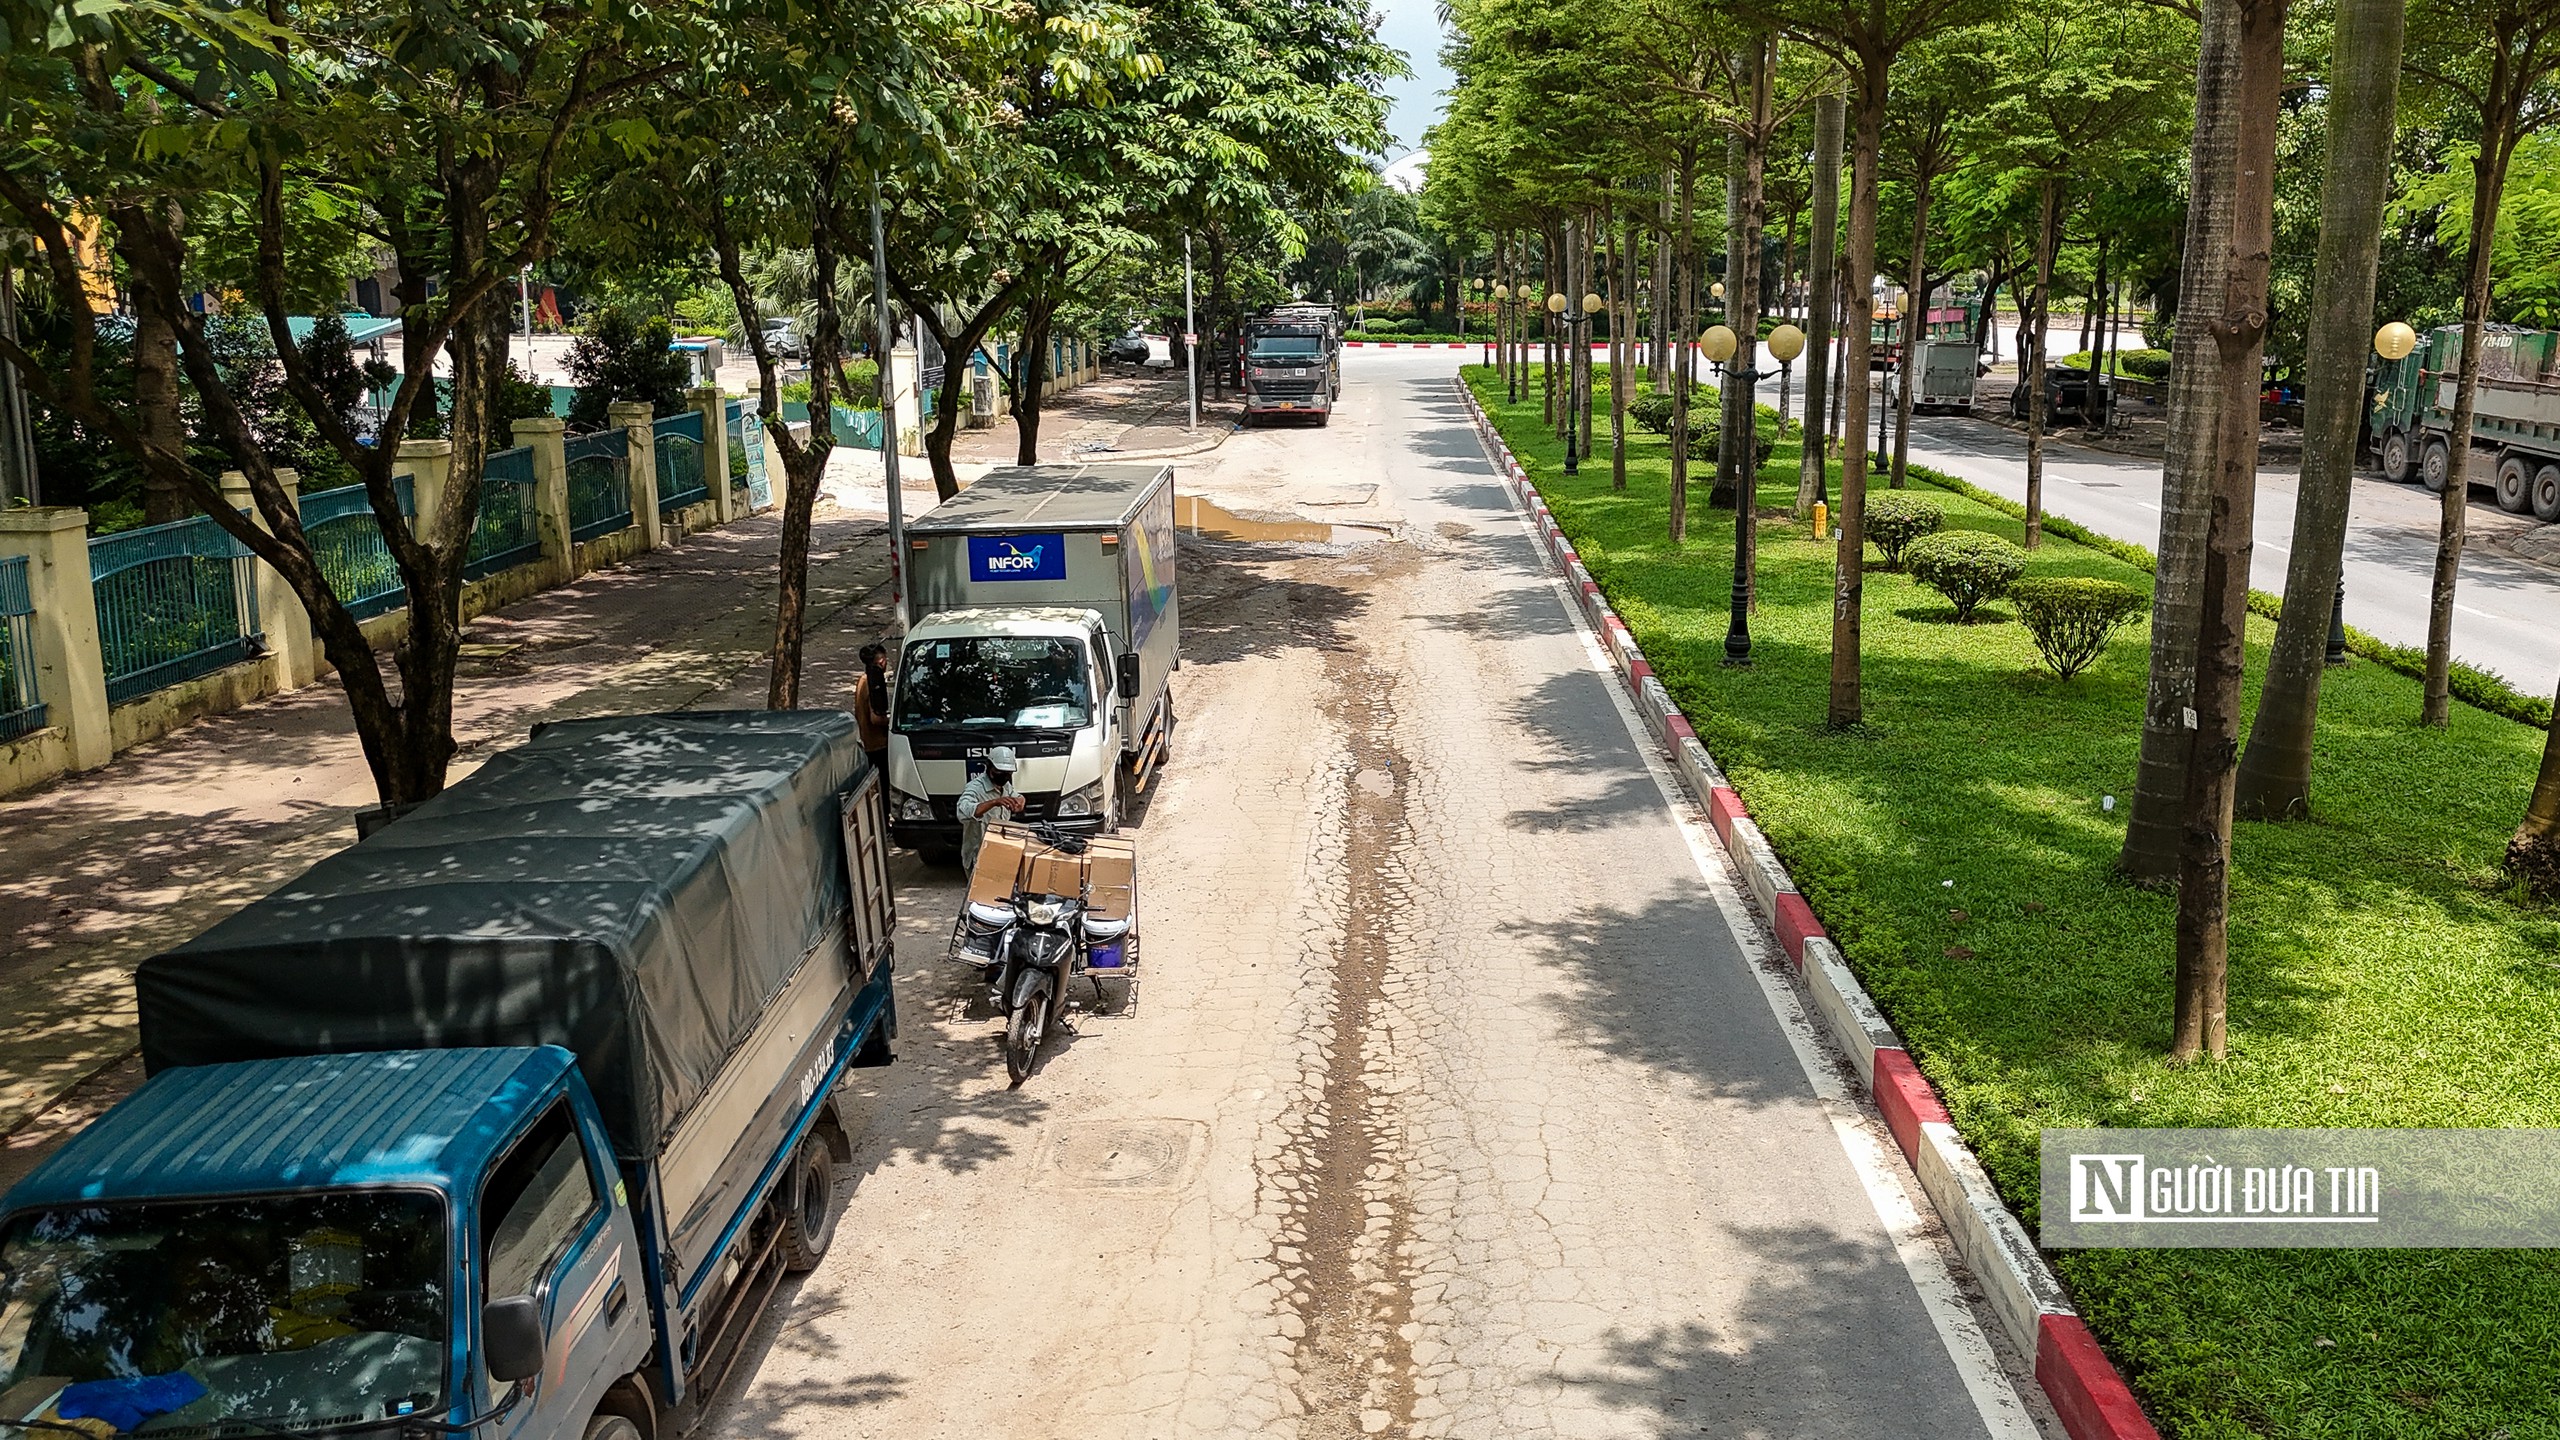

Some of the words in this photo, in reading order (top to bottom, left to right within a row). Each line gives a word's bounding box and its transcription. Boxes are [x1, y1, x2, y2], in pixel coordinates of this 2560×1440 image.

[988, 556, 1034, 569] INFOR
[966, 746, 1017, 758] ISU
[1041, 746, 1069, 754] QKR
